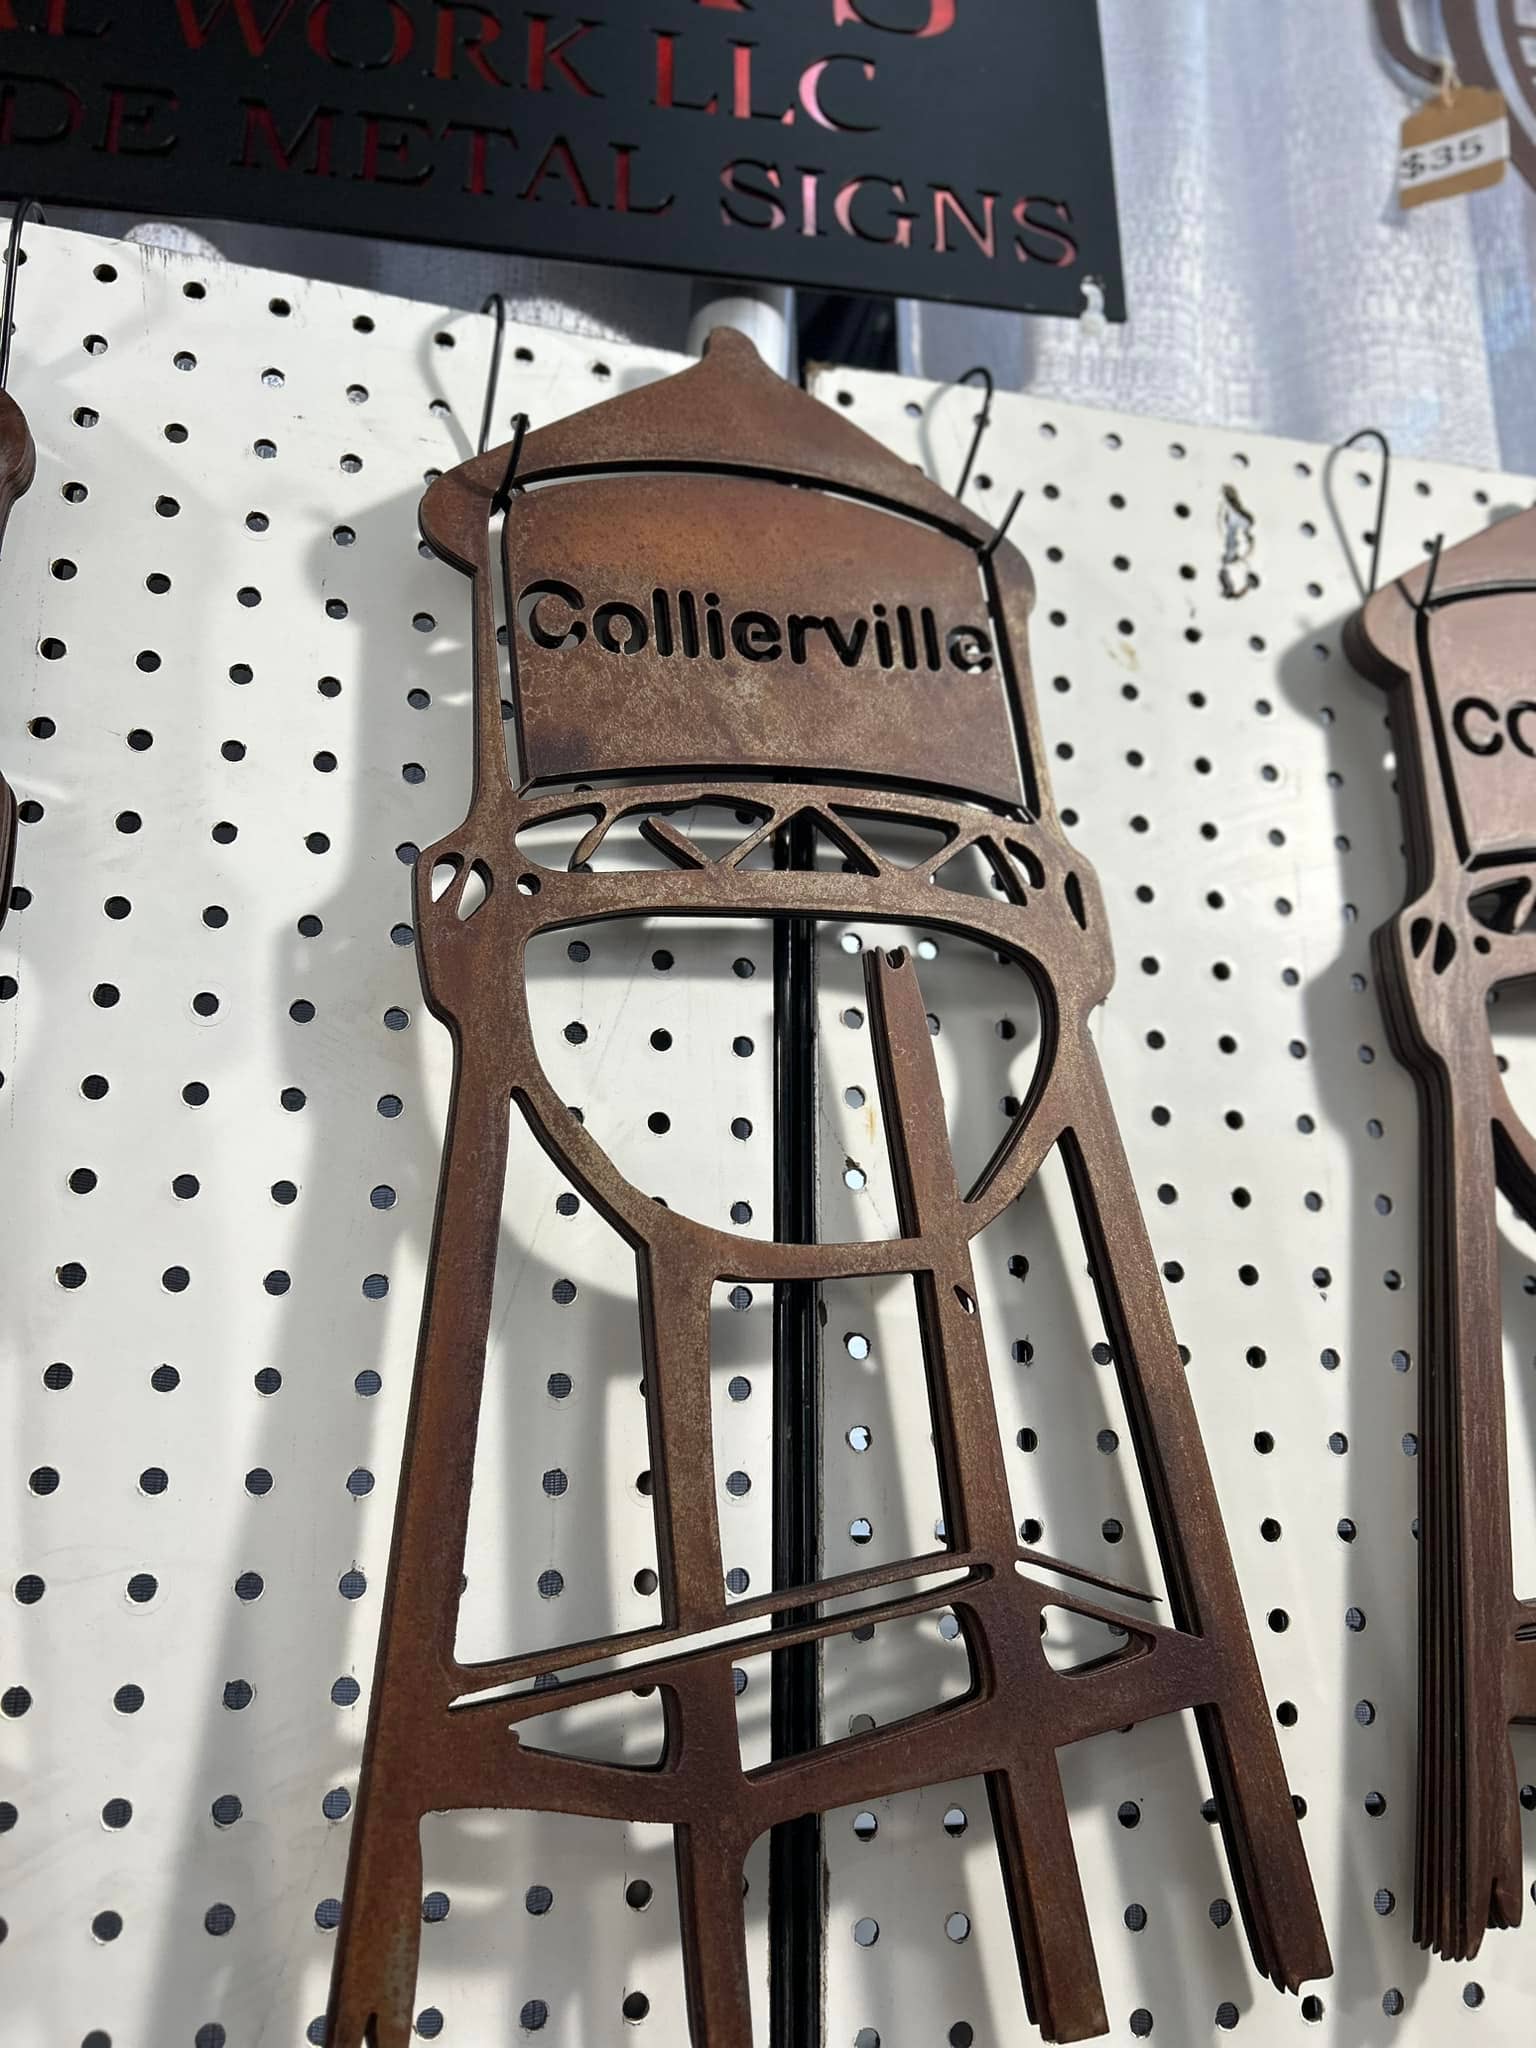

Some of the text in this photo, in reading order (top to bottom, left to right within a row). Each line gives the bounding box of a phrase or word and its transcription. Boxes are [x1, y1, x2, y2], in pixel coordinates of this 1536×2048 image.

[175, 0, 605, 98] WORK
[650, 29, 881, 132] LLC
[230, 99, 675, 216] METAL
[719, 158, 1079, 268] SIGNS
[1400, 135, 1484, 180] $35
[517, 578, 994, 674] Collierville
